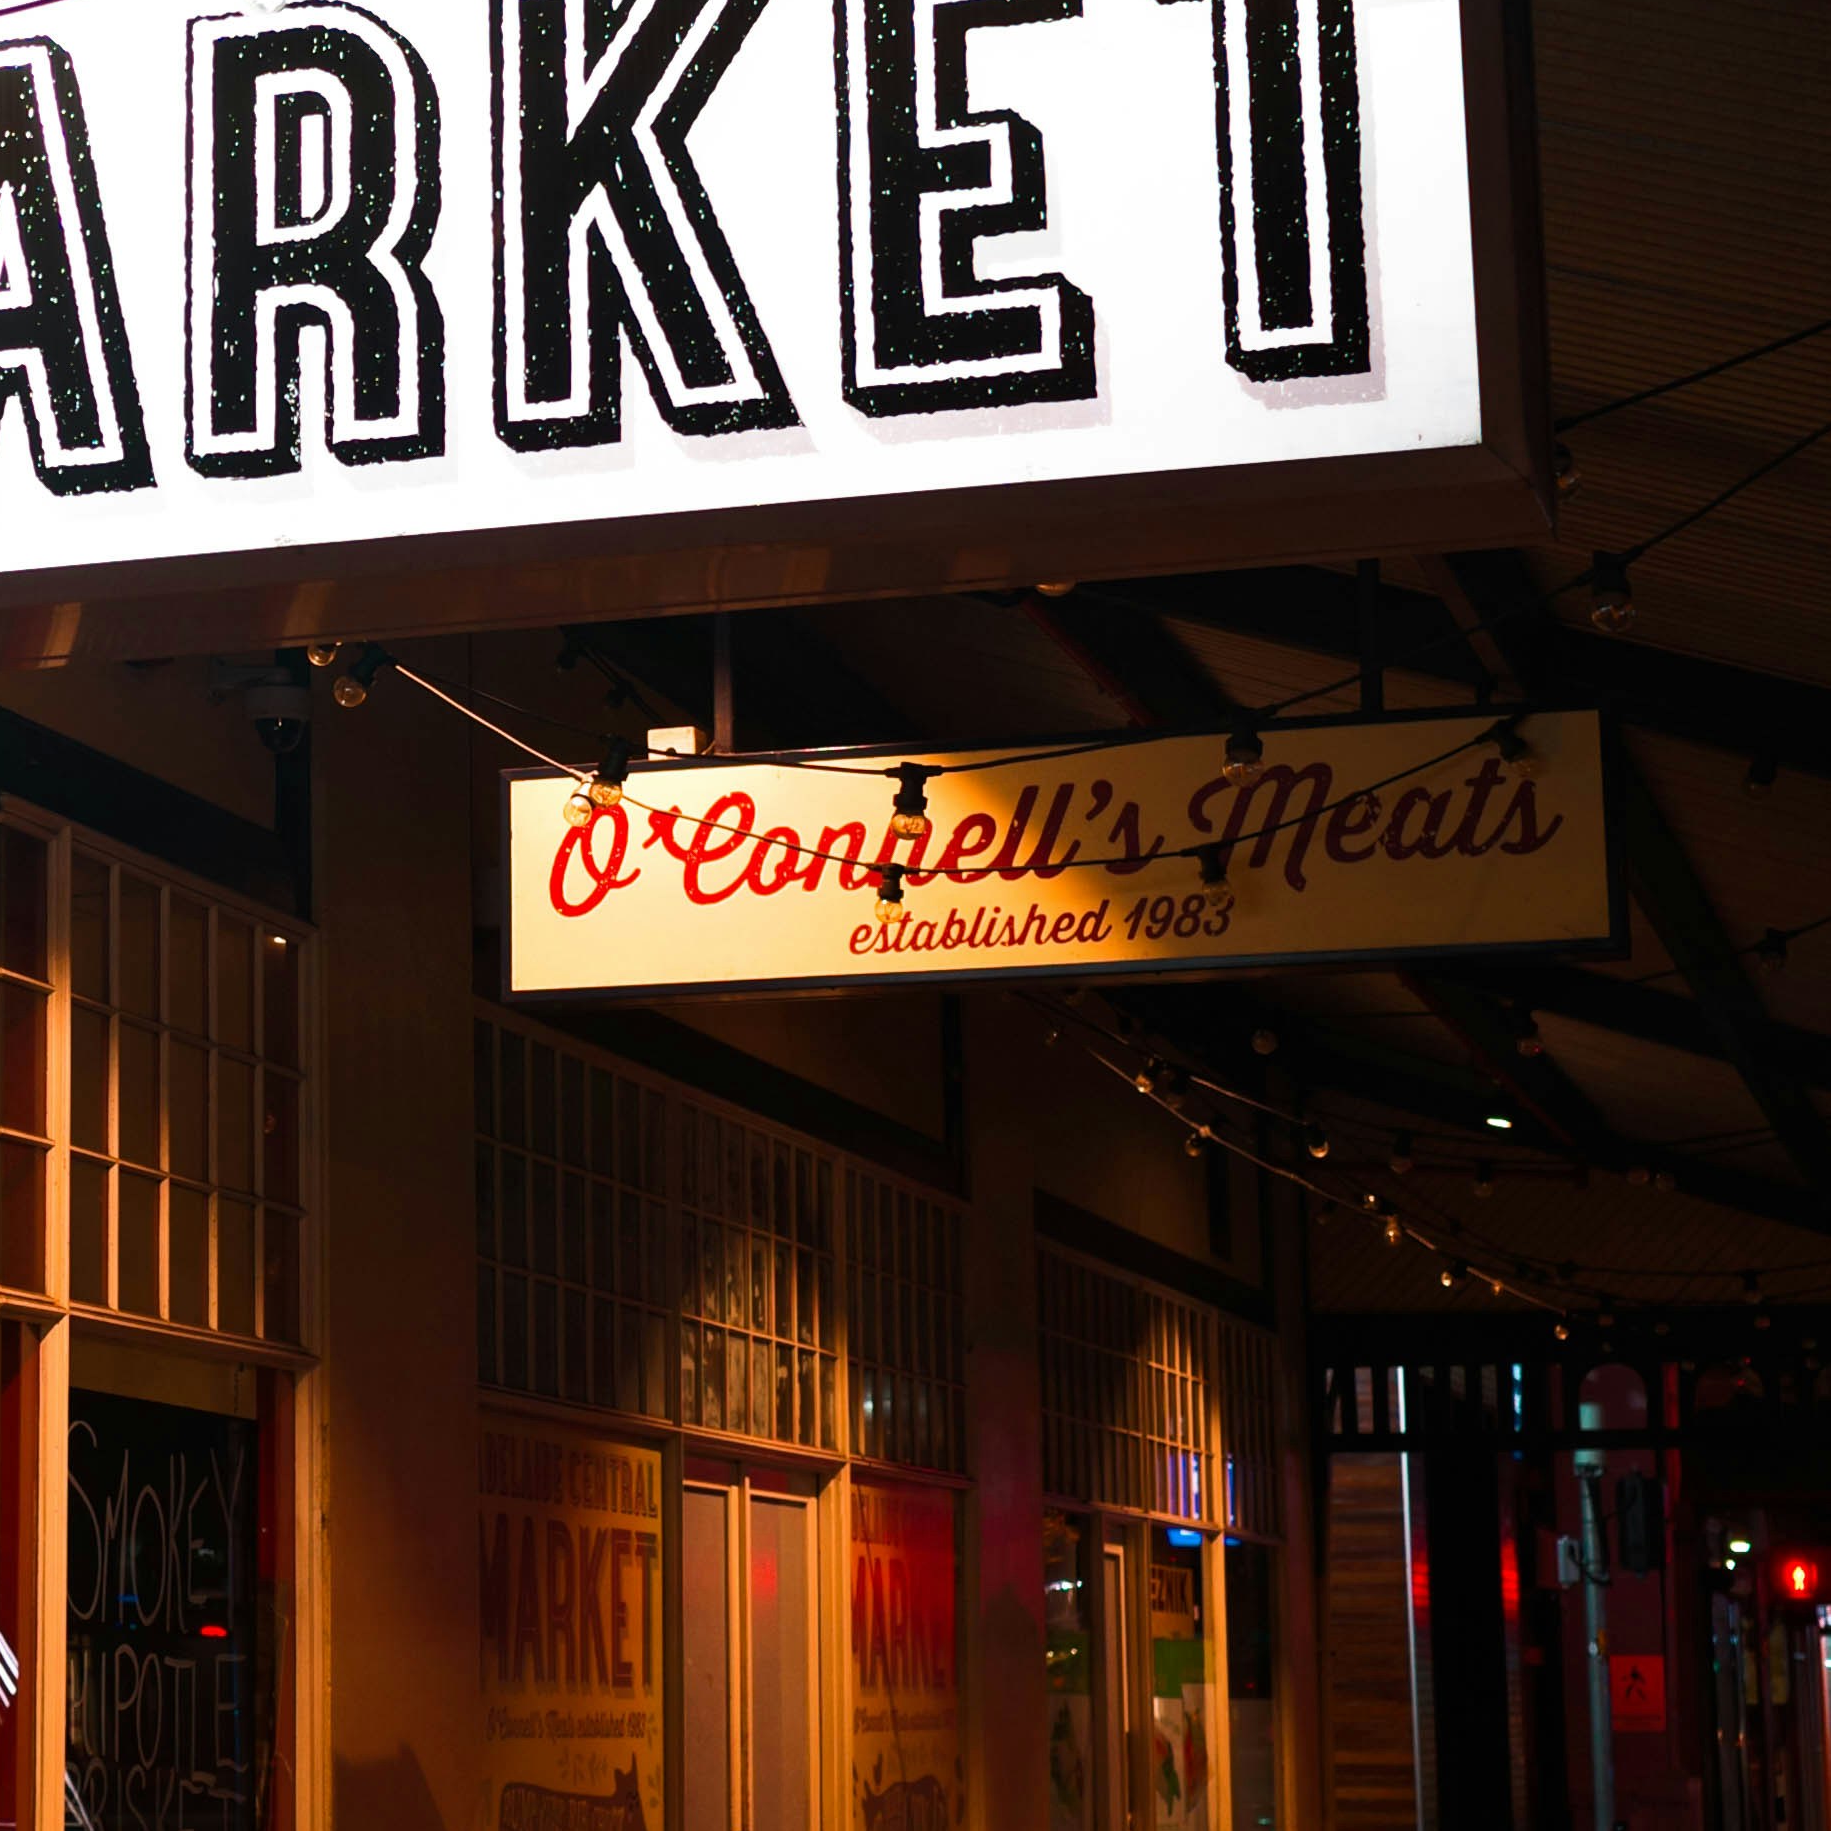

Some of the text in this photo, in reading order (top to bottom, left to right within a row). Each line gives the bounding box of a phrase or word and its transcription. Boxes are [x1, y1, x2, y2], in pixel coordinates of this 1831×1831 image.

[549, 757, 1564, 918] O'Connell's Meats
[850, 893, 1234, 954] established 1983
[67, 1420, 245, 1634] SMOKEY
[478, 1508, 659, 1699] MARKET
